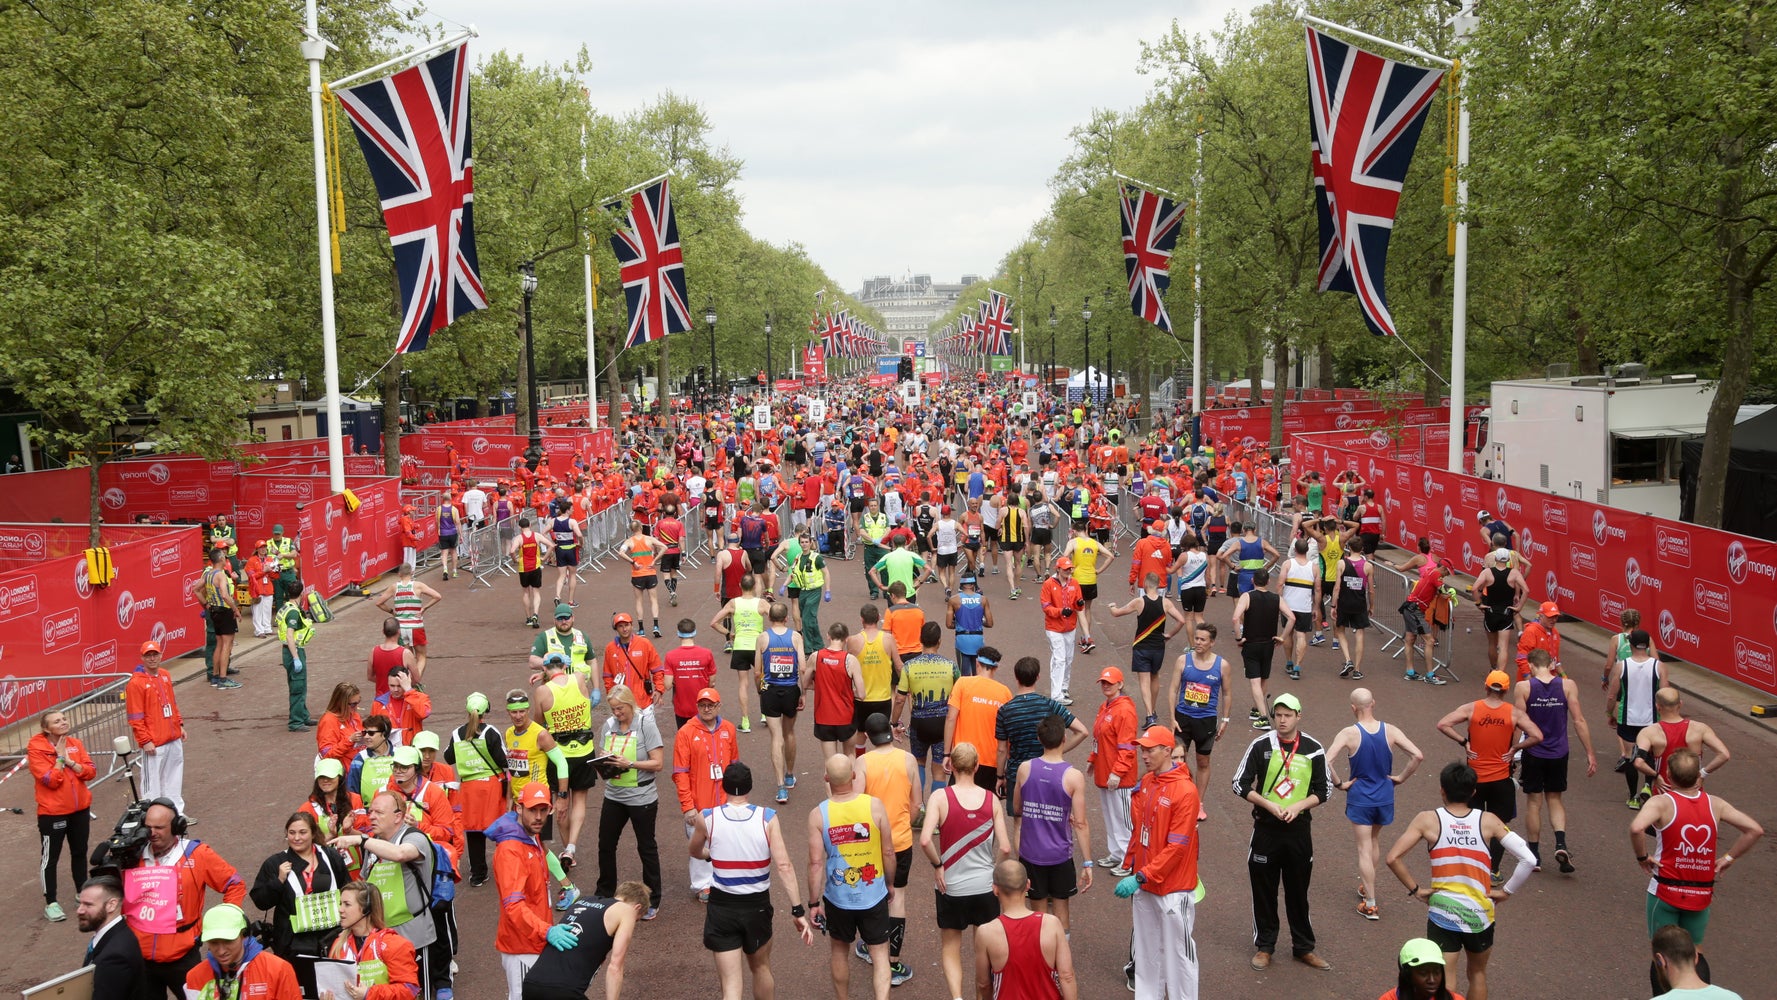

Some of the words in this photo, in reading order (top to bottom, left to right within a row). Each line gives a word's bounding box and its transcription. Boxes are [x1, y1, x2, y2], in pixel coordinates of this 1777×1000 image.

[1507, 500, 1522, 514] money
[1606, 525, 1626, 542] money
[1667, 536, 1684, 546] LONDON
[1532, 541, 1548, 556] money
[1667, 544, 1688, 555] MARATHON
[1471, 554, 1485, 565] mone
[1748, 560, 1776, 581] money
[1641, 573, 1662, 593] money
[10, 584, 30, 596] LONDON
[1557, 585, 1576, 602] money
[1705, 589, 1723, 601] LONDON
[11, 592, 36, 604] MARATHON
[134, 596, 156, 611] money
[1706, 597, 1729, 611] MARATHON
[55, 618, 73, 629] LONDON
[55, 624, 79, 636] MARATHON
[166, 626, 187, 642] money
[1676, 628, 1700, 648] money
[94, 649, 111, 660] LONDON
[1747, 649, 1766, 661] LONDON
[1747, 657, 1773, 672] MARATHON
[20, 680, 47, 698] money
[972, 696, 987, 704] RUN
[1185, 690, 1209, 701] 33639
[551, 701, 587, 717] RUNNING
[565, 710, 585, 721] BEAT
[553, 717, 581, 729] BLOOD
[1045, 804, 1064, 812] SUPPORT
[829, 826, 853, 835] children
[1446, 836, 1478, 846] victa
[1674, 862, 1710, 871] Foundation
[318, 892, 336, 900] MONEY
[139, 905, 156, 922] 80
[312, 907, 328, 915] 2017
